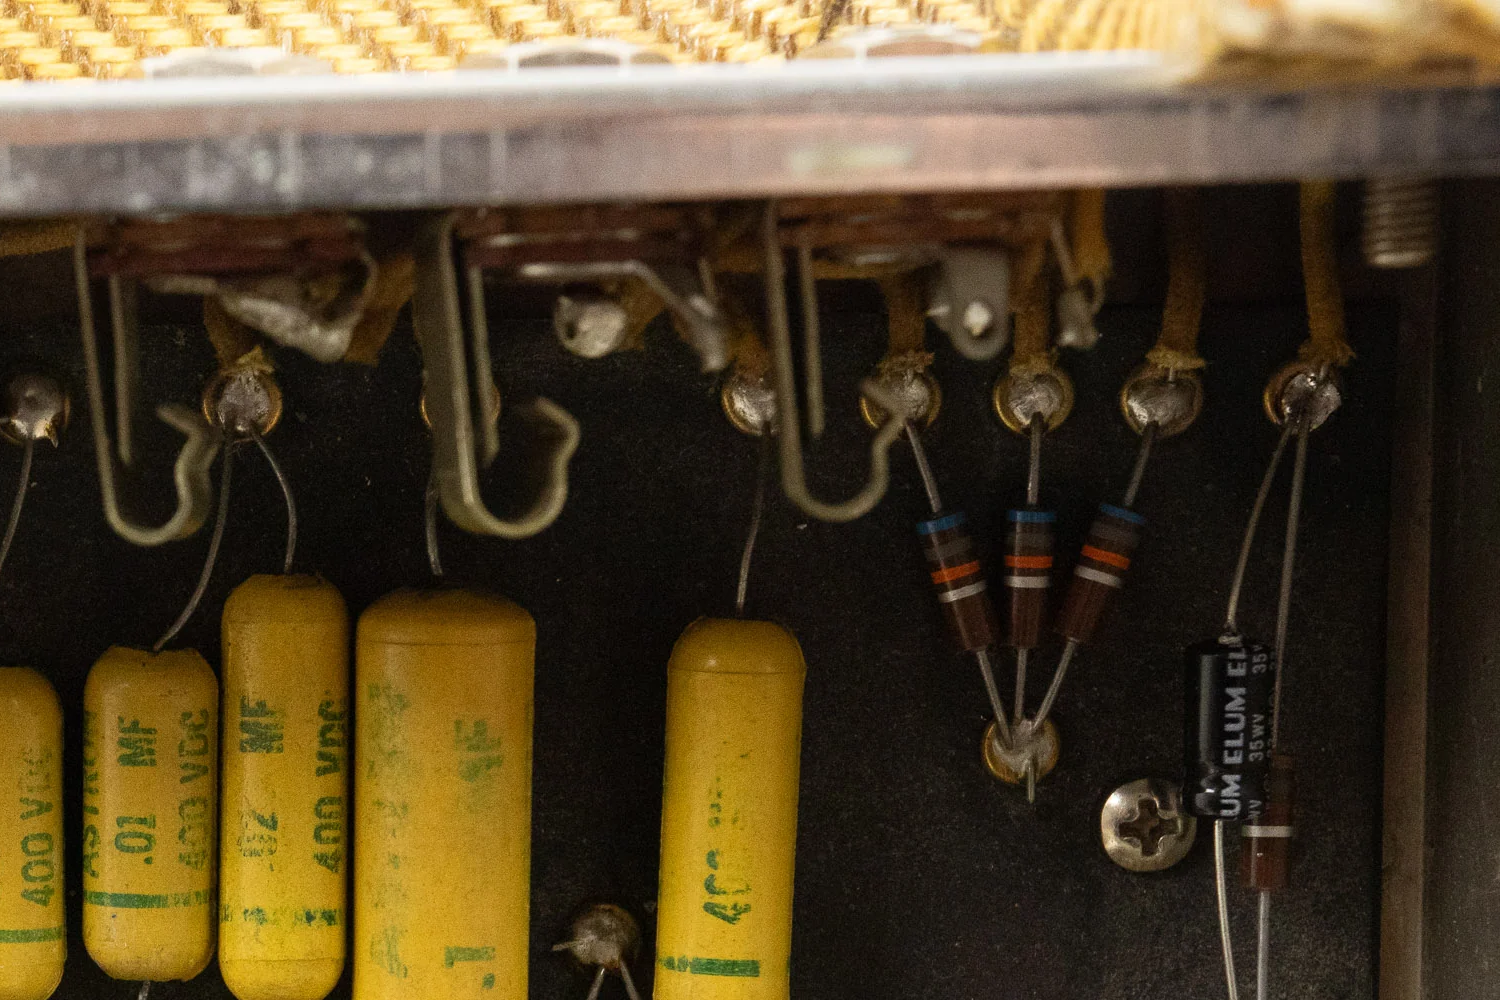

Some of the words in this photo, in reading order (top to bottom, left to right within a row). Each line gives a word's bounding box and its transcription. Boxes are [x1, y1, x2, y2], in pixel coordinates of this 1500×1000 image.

[117, 716, 157, 767] MF
[178, 708, 210, 784] VDC
[239, 695, 284, 753] MF
[1223, 687, 1247, 764] ELUM
[1248, 714, 1265, 762] 35WV
[115, 814, 157, 865] .01
[20, 832, 54, 907] 400
